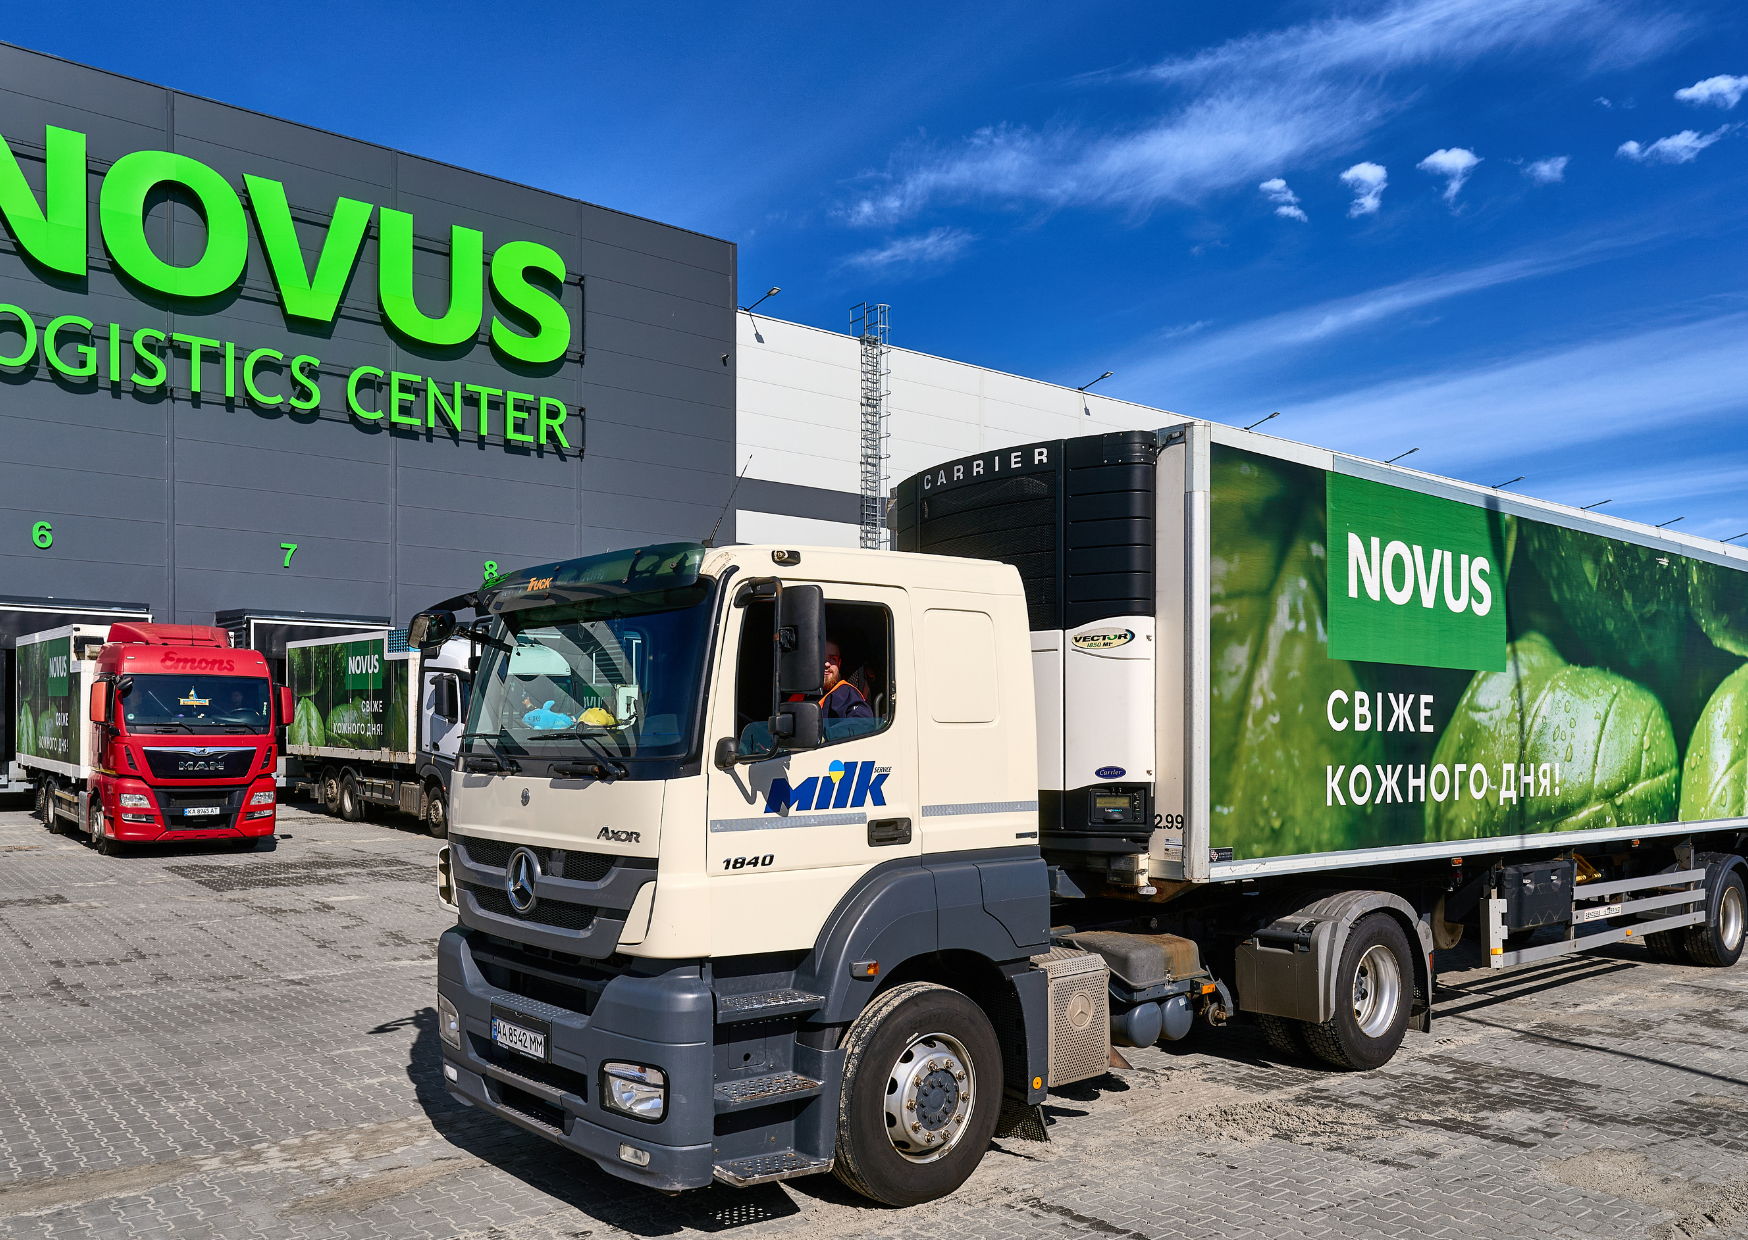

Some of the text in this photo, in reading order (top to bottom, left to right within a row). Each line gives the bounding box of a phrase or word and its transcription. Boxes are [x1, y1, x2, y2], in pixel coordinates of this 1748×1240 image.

[0, 124, 571, 363] NOVUS
[347, 366, 571, 449] CENTER
[924, 447, 1048, 490] CARRIER
[32, 521, 54, 549] 6
[280, 543, 298, 568] 7
[484, 560, 499, 581] 8
[1347, 531, 1492, 617] NOVUS
[1073, 633, 1129, 643] VECTOR
[160, 650, 235, 672] Emons
[348, 654, 379, 675] NOVUS
[361, 700, 383, 712] СВІЖЕ
[1327, 689, 1435, 733] СВІЖЕ
[333, 722, 383, 739] КОЖНОГО ДНЯ!
[178, 761, 224, 771] MAN
[1327, 762, 1560, 807] КОЖНОГО ДНЯ!
[722, 854, 775, 870] 1840
[497, 1021, 543, 1055] AA 8542 MM
